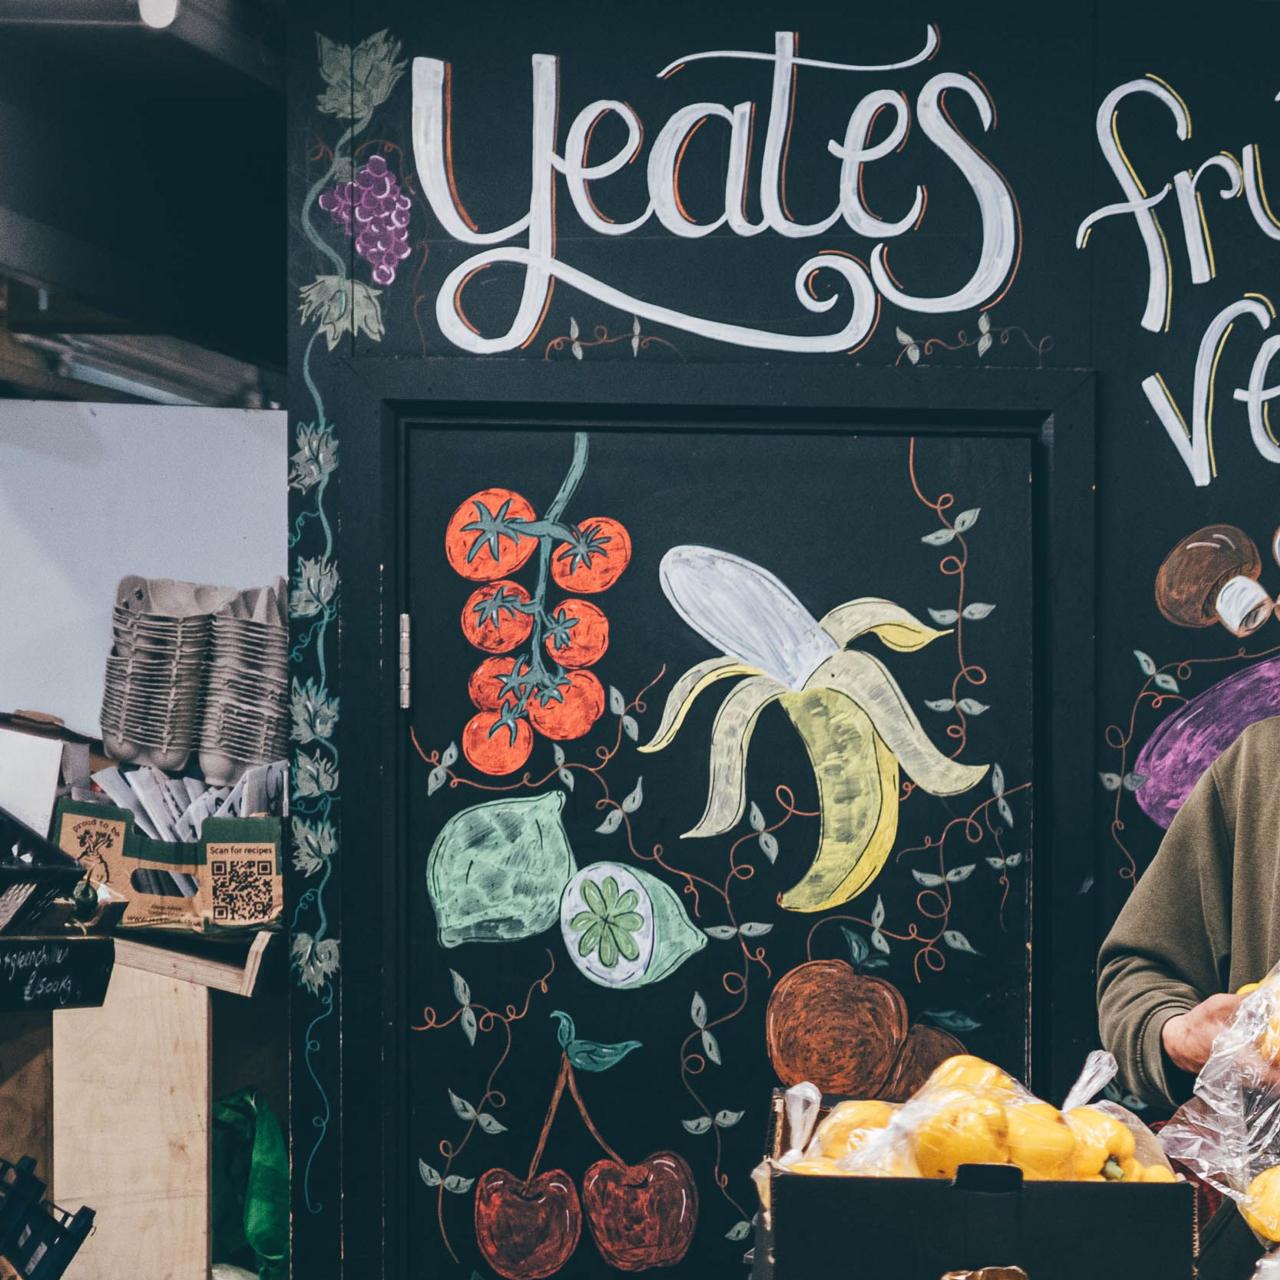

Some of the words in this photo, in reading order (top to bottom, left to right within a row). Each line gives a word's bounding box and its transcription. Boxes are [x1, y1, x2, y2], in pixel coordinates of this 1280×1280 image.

[411, 24, 1022, 354] Yeates
[72, 819, 97, 832] proud
[98, 820, 110, 829] to
[209, 846, 229, 855] Scan
[230, 846, 243, 855] for
[244, 847, 273, 856] recipes
